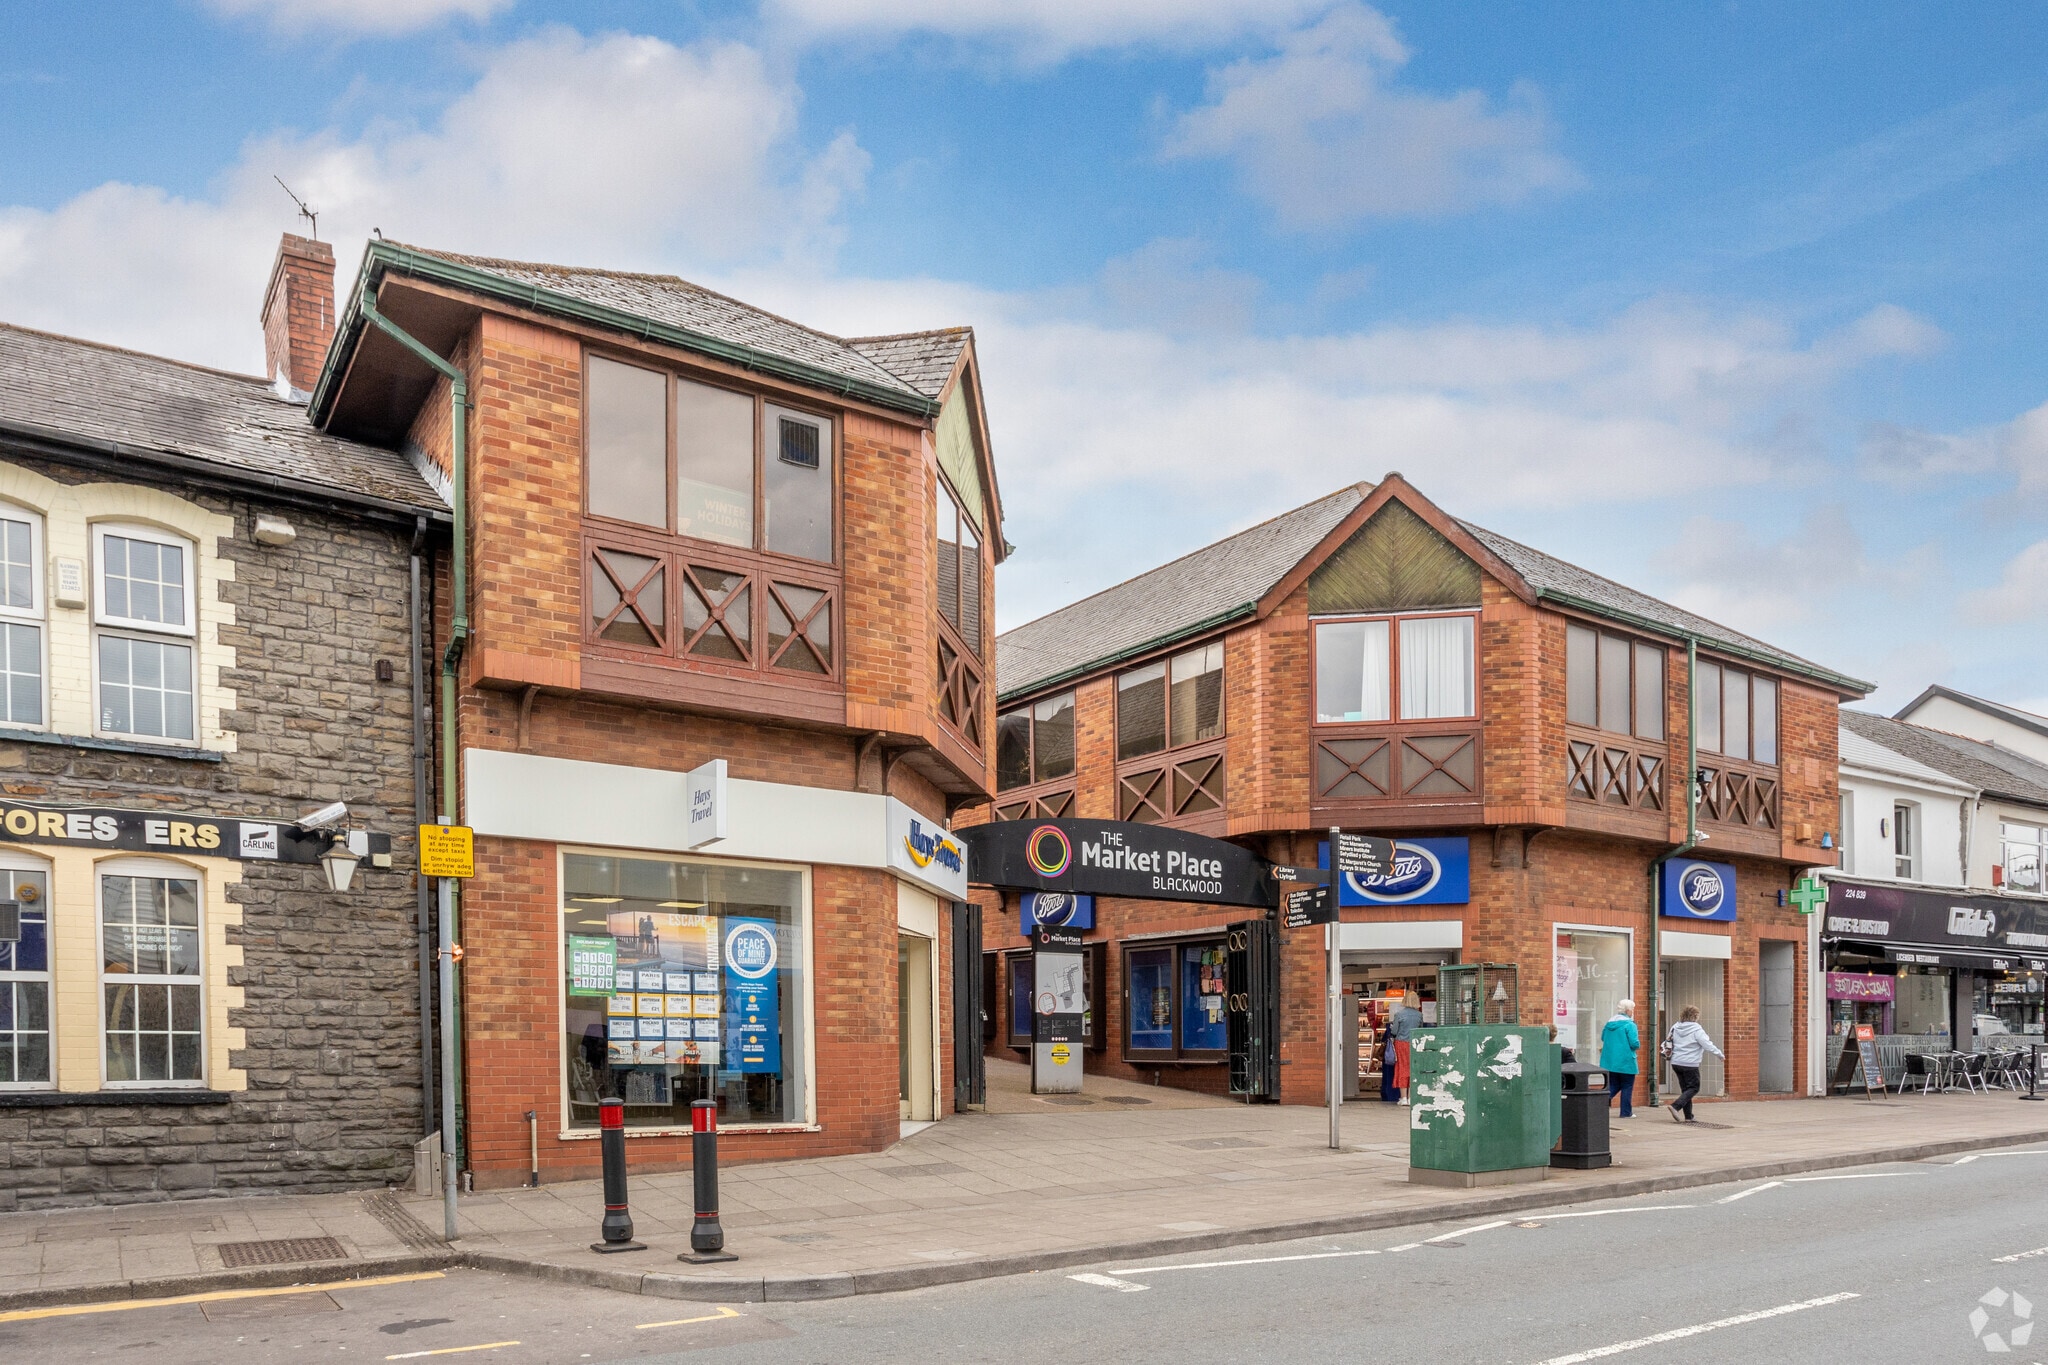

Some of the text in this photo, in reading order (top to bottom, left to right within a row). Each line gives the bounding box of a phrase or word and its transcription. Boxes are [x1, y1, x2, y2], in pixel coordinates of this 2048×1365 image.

[704, 498, 746, 518] WINTER
[697, 510, 752, 532] HOLIDAYS
[693, 789, 711, 806] Hays
[691, 801, 713, 824] Travel
[0, 808, 221, 849] ORES ERS
[242, 839, 275, 850] CARLING
[910, 818, 962, 873] Hays Travel
[1100, 831, 1123, 847] THE
[1081, 841, 1223, 878] Market Place
[1279, 866, 1295, 874] Library
[1152, 876, 1223, 895] BLACKWOOD
[1689, 875, 1719, 902] Boots
[1845, 889, 1867, 899] 224 839
[1036, 893, 1065, 919] Boots
[668, 913, 707, 928] ESCAPE
[1828, 916, 1852, 932] CAFE
[1859, 919, 1890, 936] BISTRO
[737, 937, 767, 950] PEACE
[737, 948, 748, 959] OF
[747, 949, 767, 960] MIND
[737, 957, 767, 966] GUARANTEE
